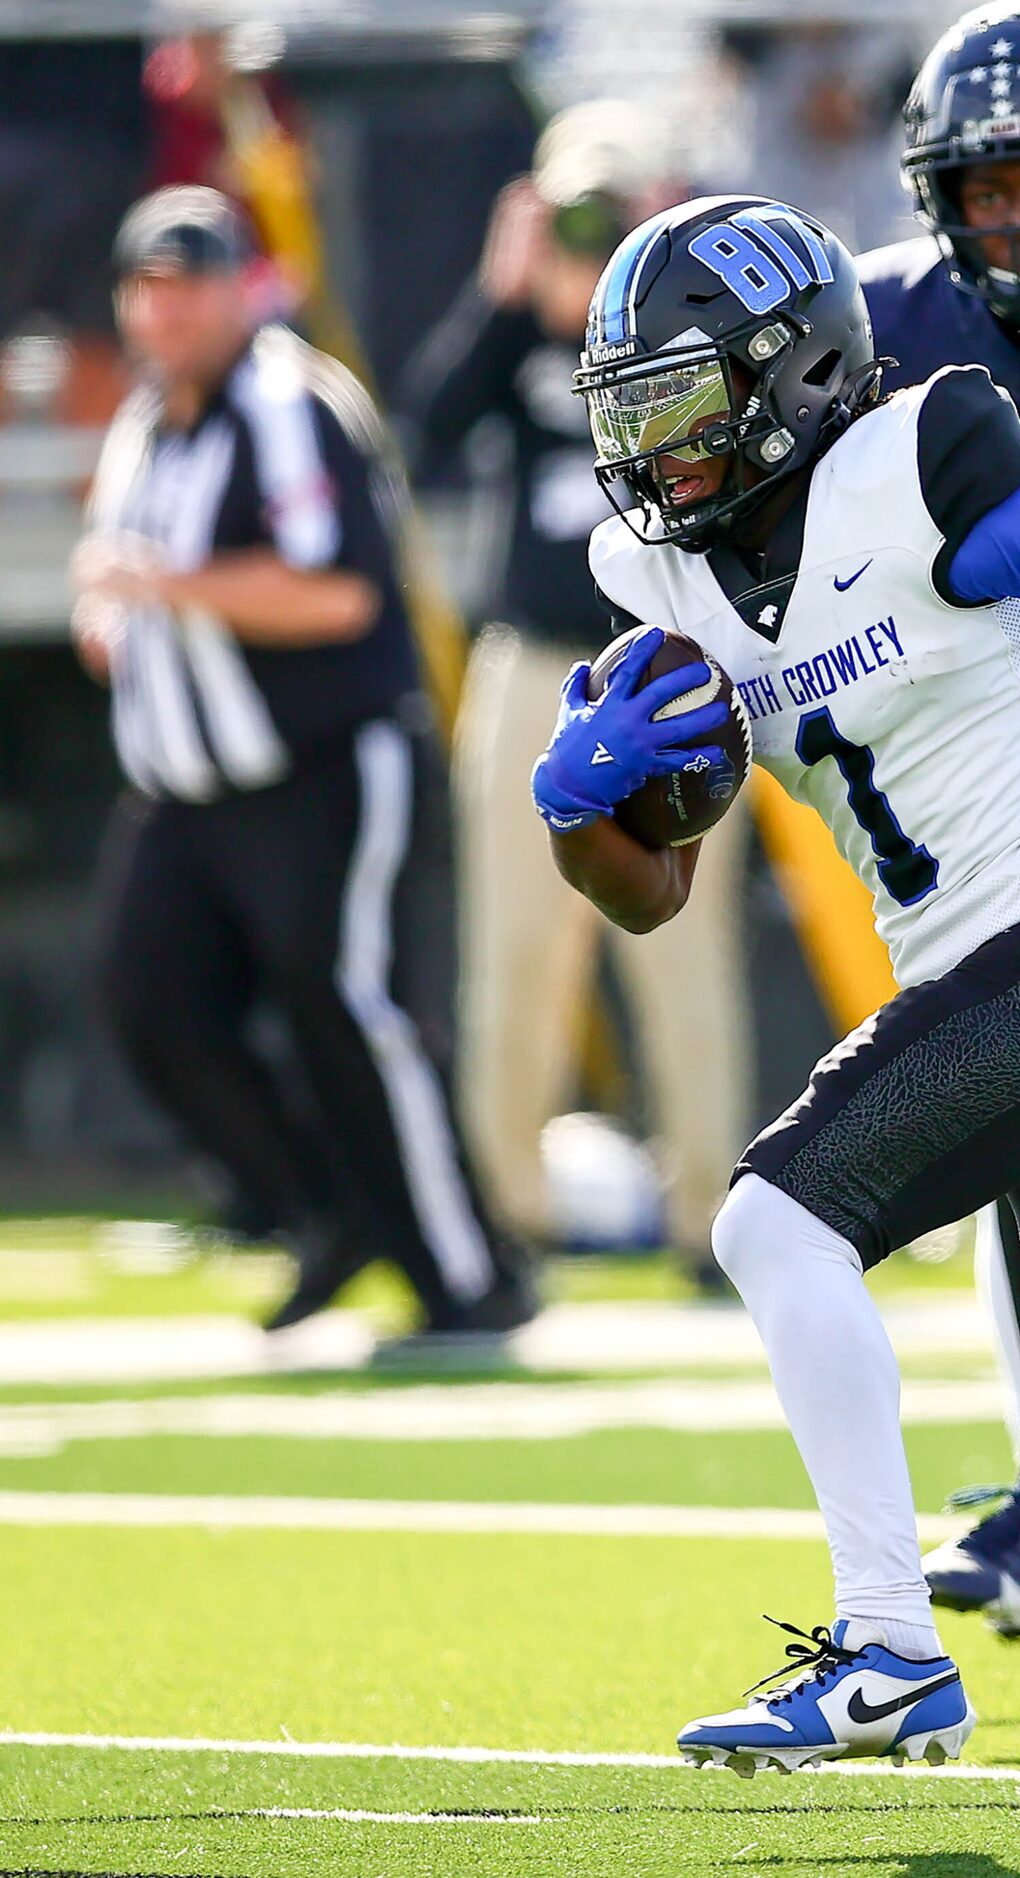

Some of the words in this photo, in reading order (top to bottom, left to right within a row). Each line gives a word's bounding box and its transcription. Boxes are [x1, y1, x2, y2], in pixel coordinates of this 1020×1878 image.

[688, 203, 834, 314] 817
[592, 341, 635, 364] Riddell
[736, 673, 783, 720] RTH
[781, 615, 904, 706] CROWLEY
[795, 705, 939, 907] 1
